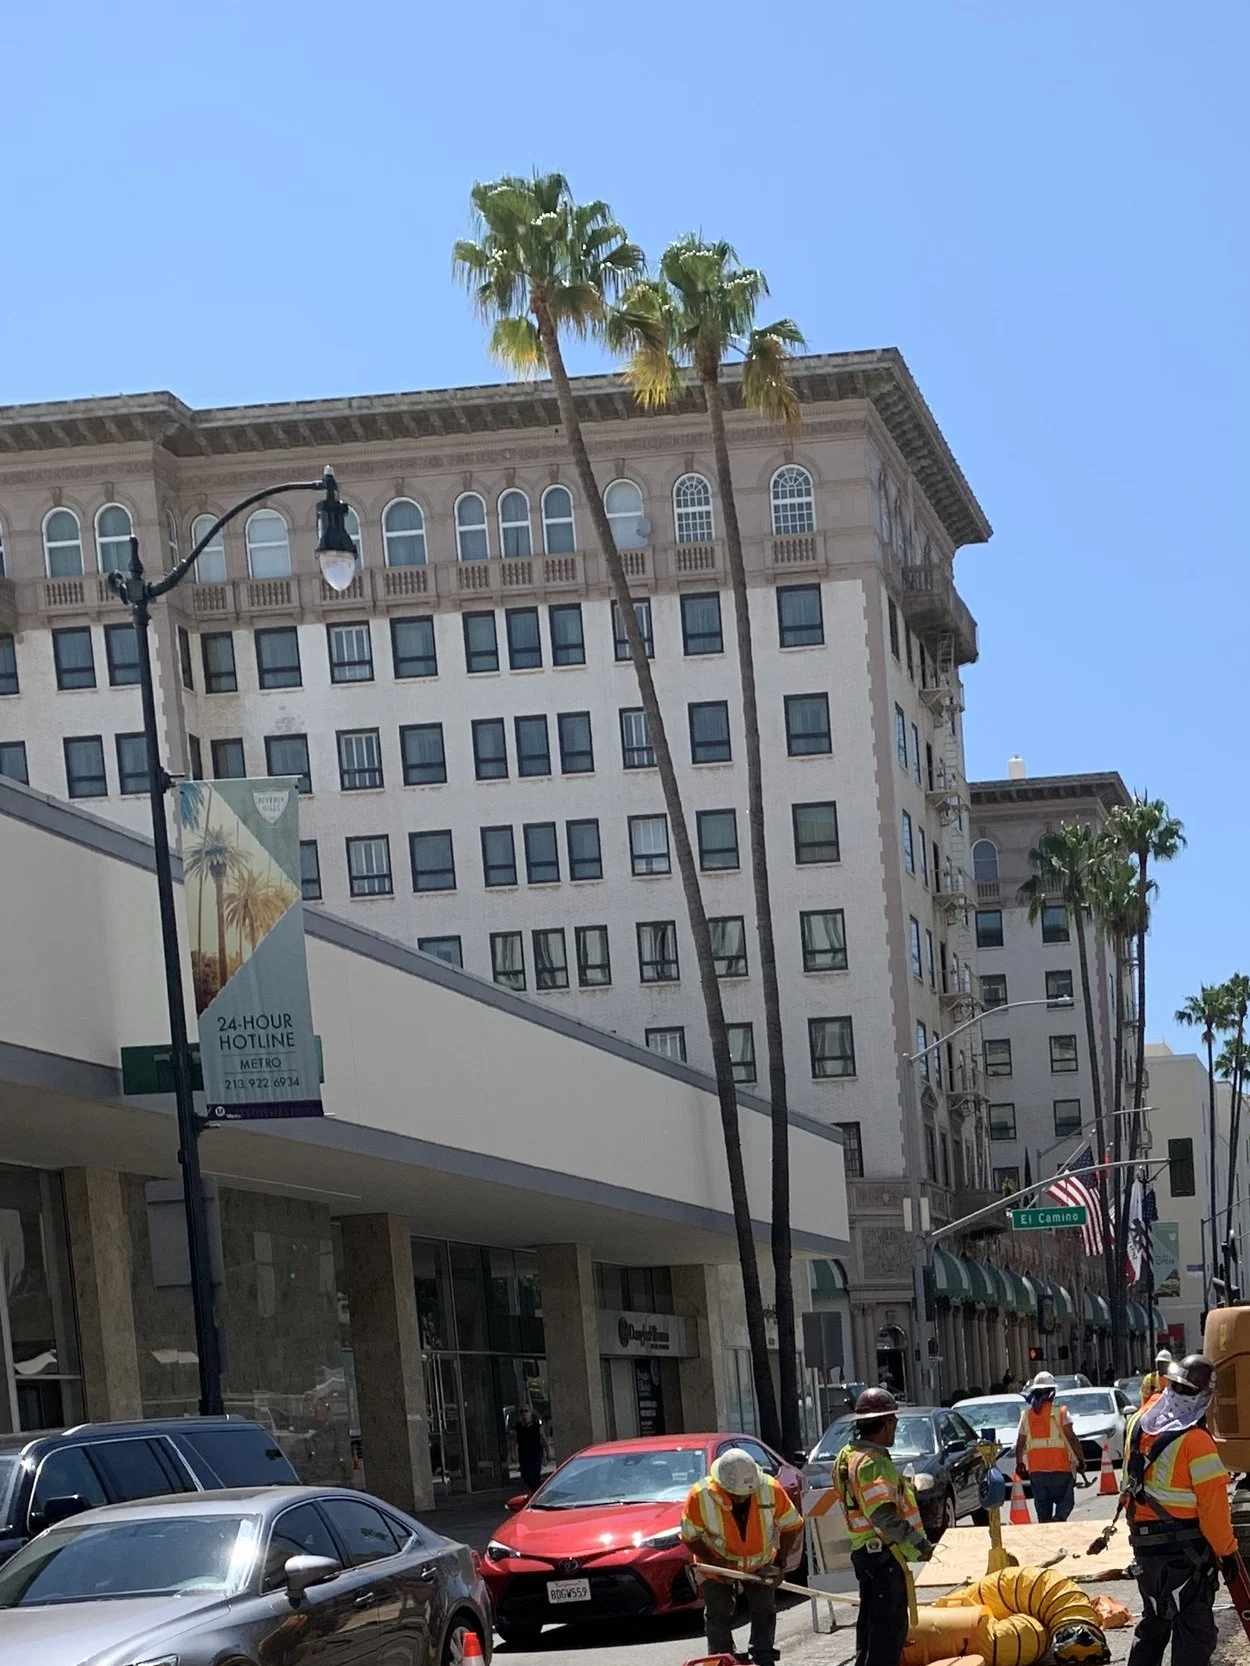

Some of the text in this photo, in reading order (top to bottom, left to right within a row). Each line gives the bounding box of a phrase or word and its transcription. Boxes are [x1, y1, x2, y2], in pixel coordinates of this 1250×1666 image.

[217, 1013, 293, 1032] 24-HOUR
[219, 1032, 296, 1050] HOTLINE
[240, 1057, 282, 1070] METRO
[1021, 1212, 1079, 1225] El Camino
